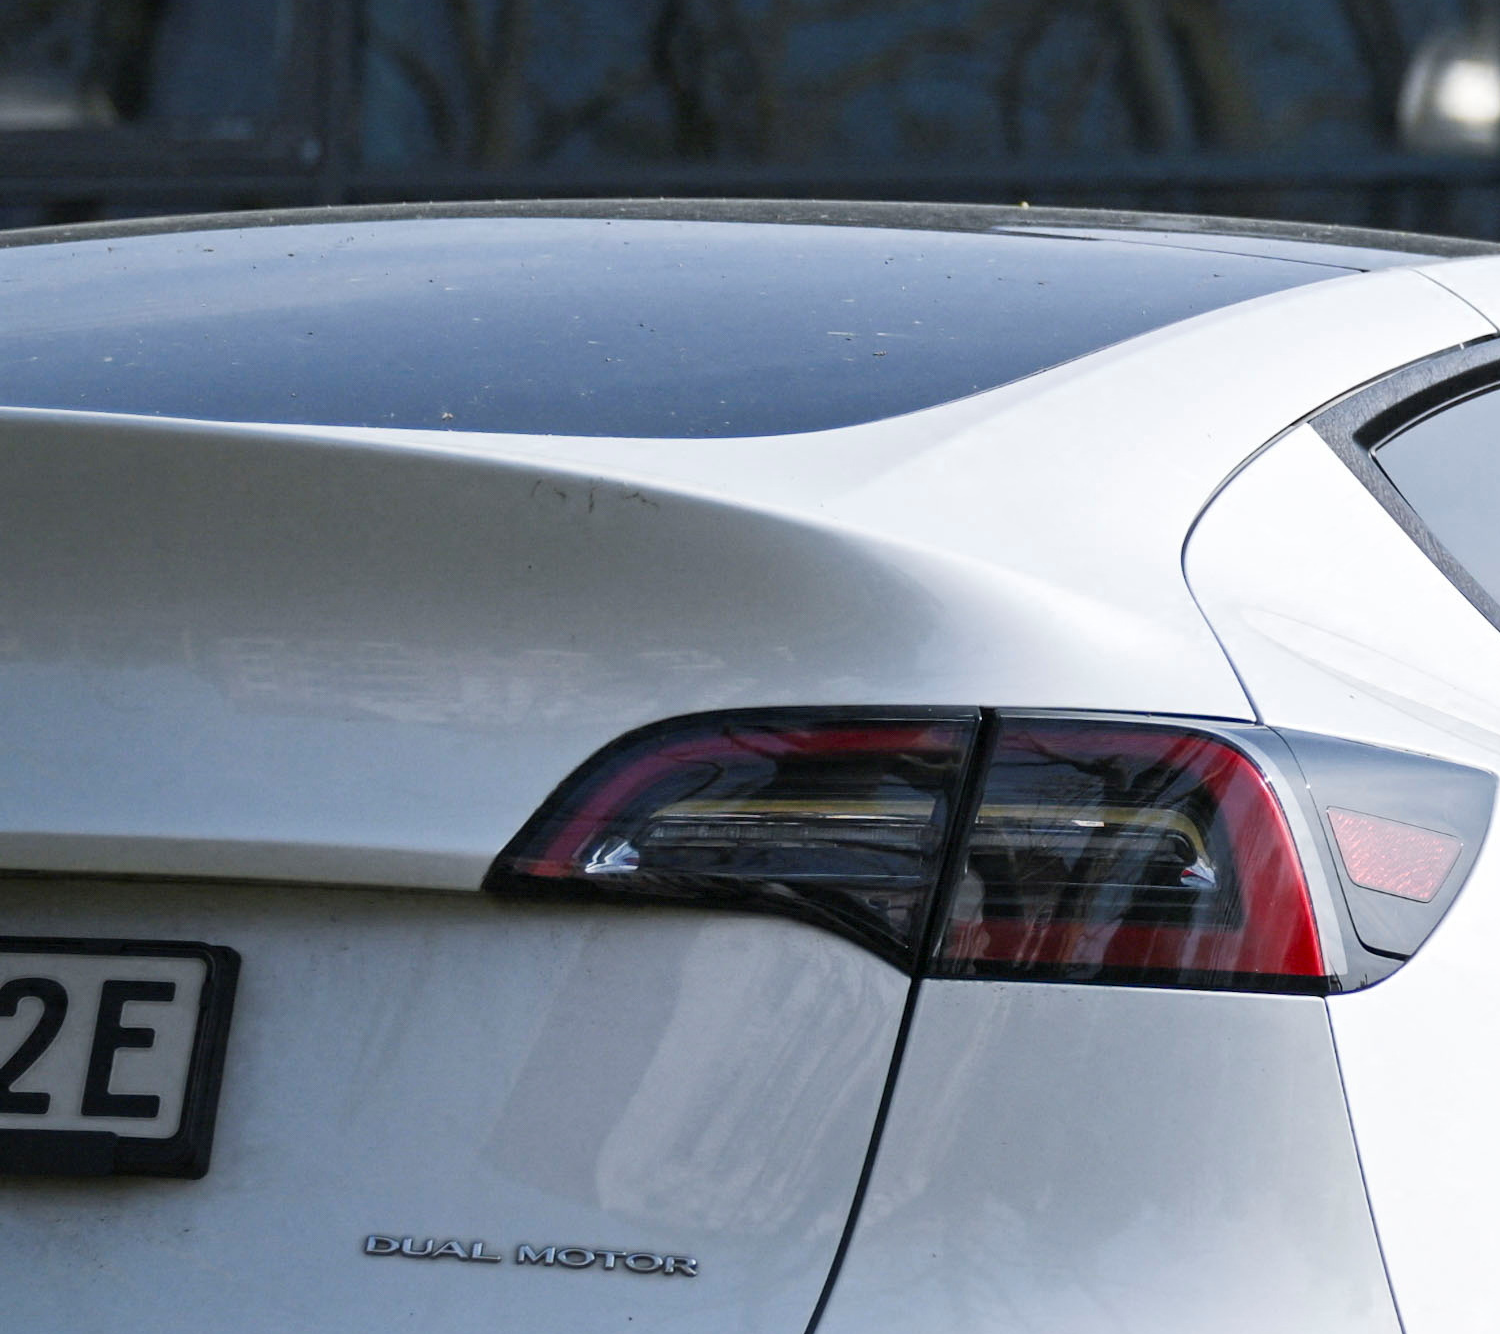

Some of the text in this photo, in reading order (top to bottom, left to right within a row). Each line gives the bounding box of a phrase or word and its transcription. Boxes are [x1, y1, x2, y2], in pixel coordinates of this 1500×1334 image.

[0, 977, 177, 1119] 2E
[363, 1234, 699, 1278] DUAL MOTOR
